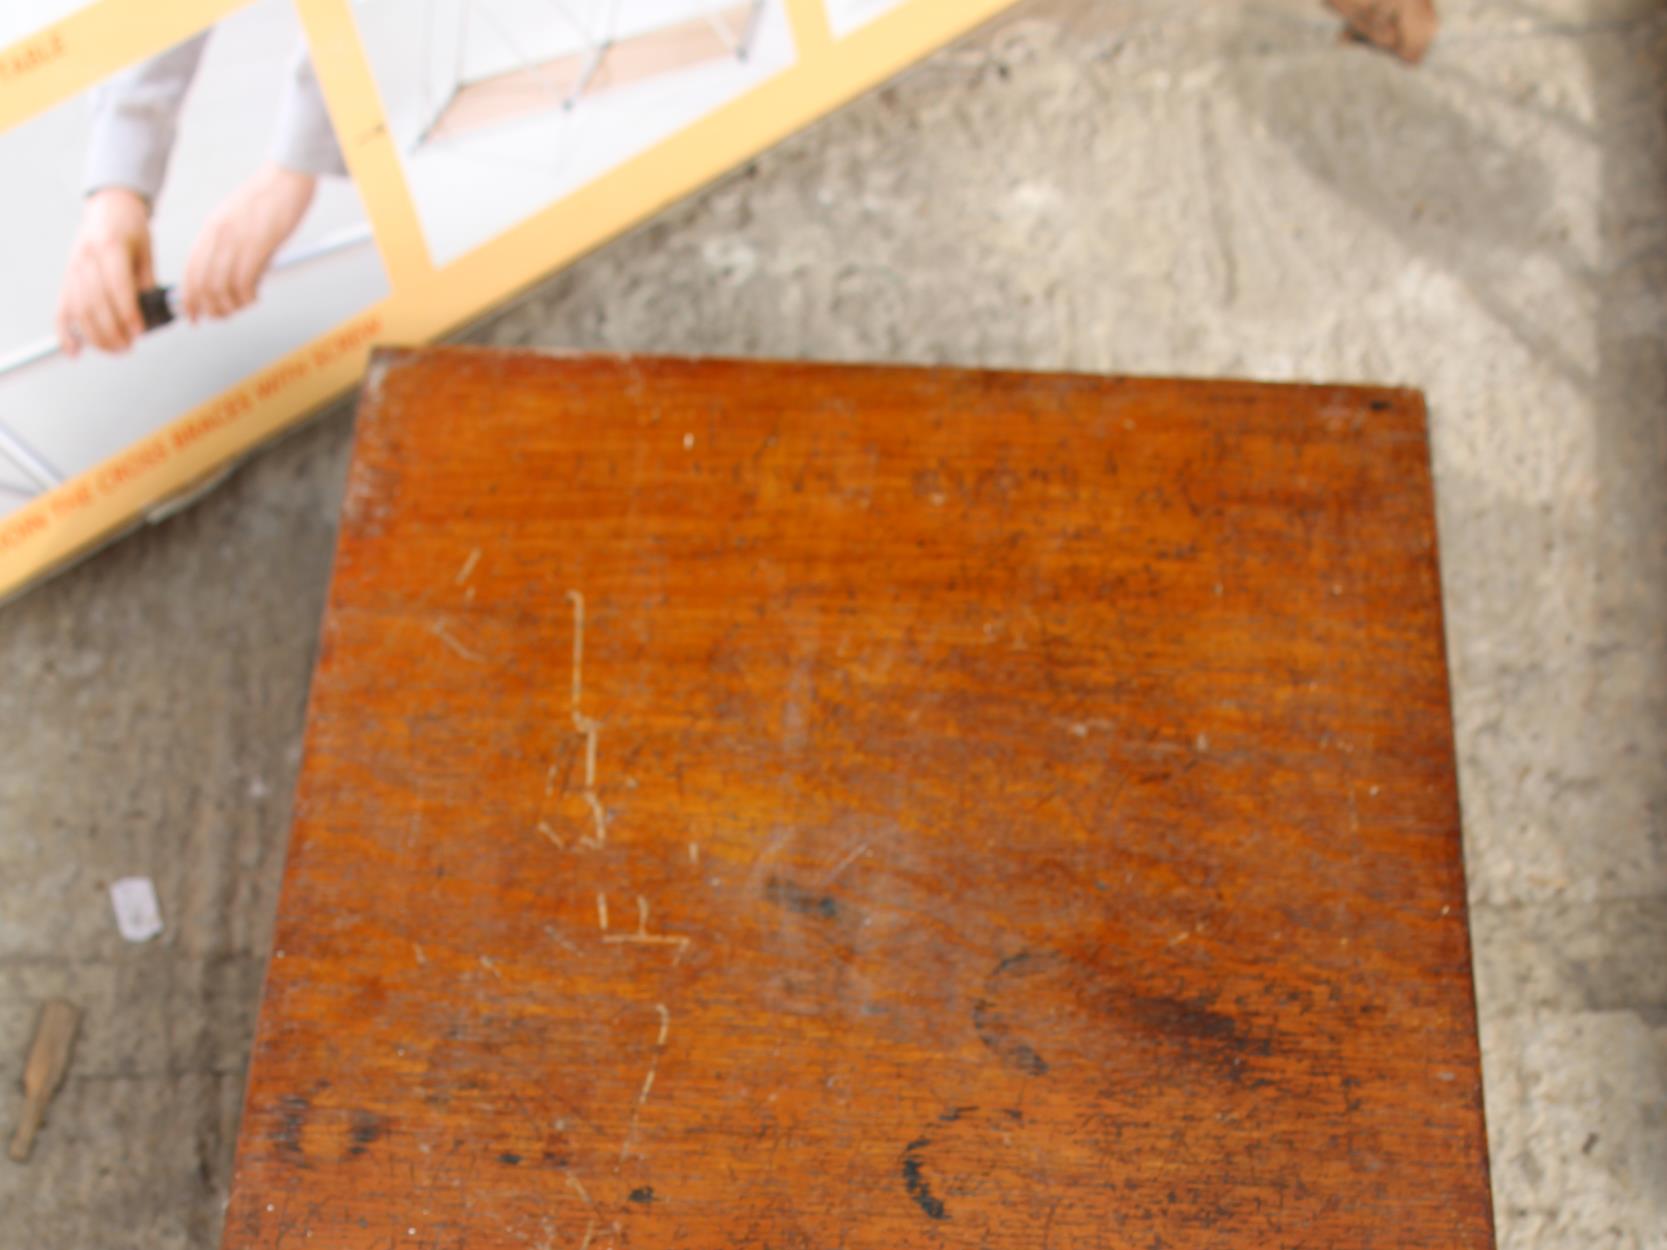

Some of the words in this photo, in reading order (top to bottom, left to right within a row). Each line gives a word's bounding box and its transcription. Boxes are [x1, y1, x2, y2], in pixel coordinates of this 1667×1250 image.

[51, 484, 93, 515] THE
[96, 441, 168, 495] CROSS
[171, 392, 252, 450] BRACES
[254, 359, 310, 399] WITH
